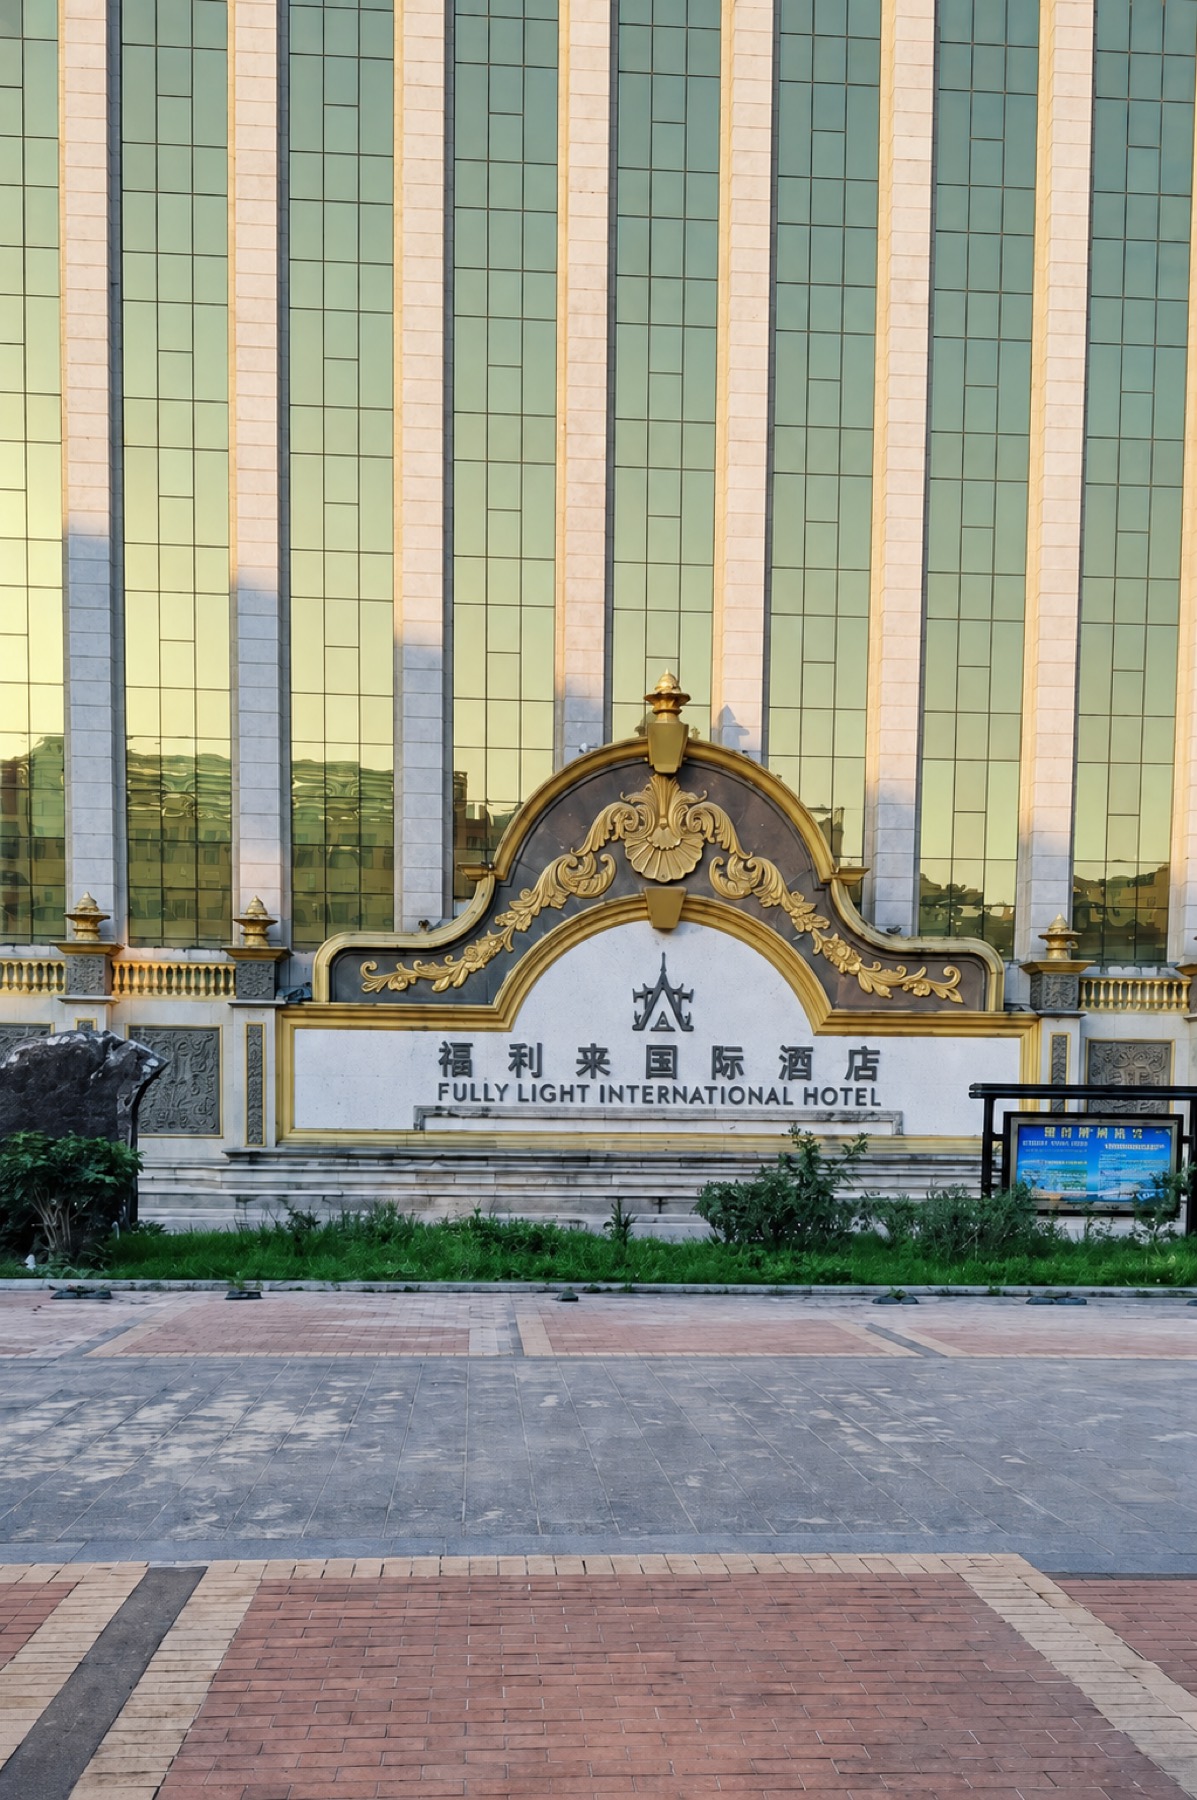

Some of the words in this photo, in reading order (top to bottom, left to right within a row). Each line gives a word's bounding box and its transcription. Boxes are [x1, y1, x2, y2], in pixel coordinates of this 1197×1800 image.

[438, 1041, 881, 1081] 福利来国际酒店
[438, 1083, 509, 1102] FULLY
[517, 1084, 591, 1103] LIGHT
[599, 1085, 794, 1106] INTERNATIONAL
[803, 1086, 882, 1106] HOTEL
